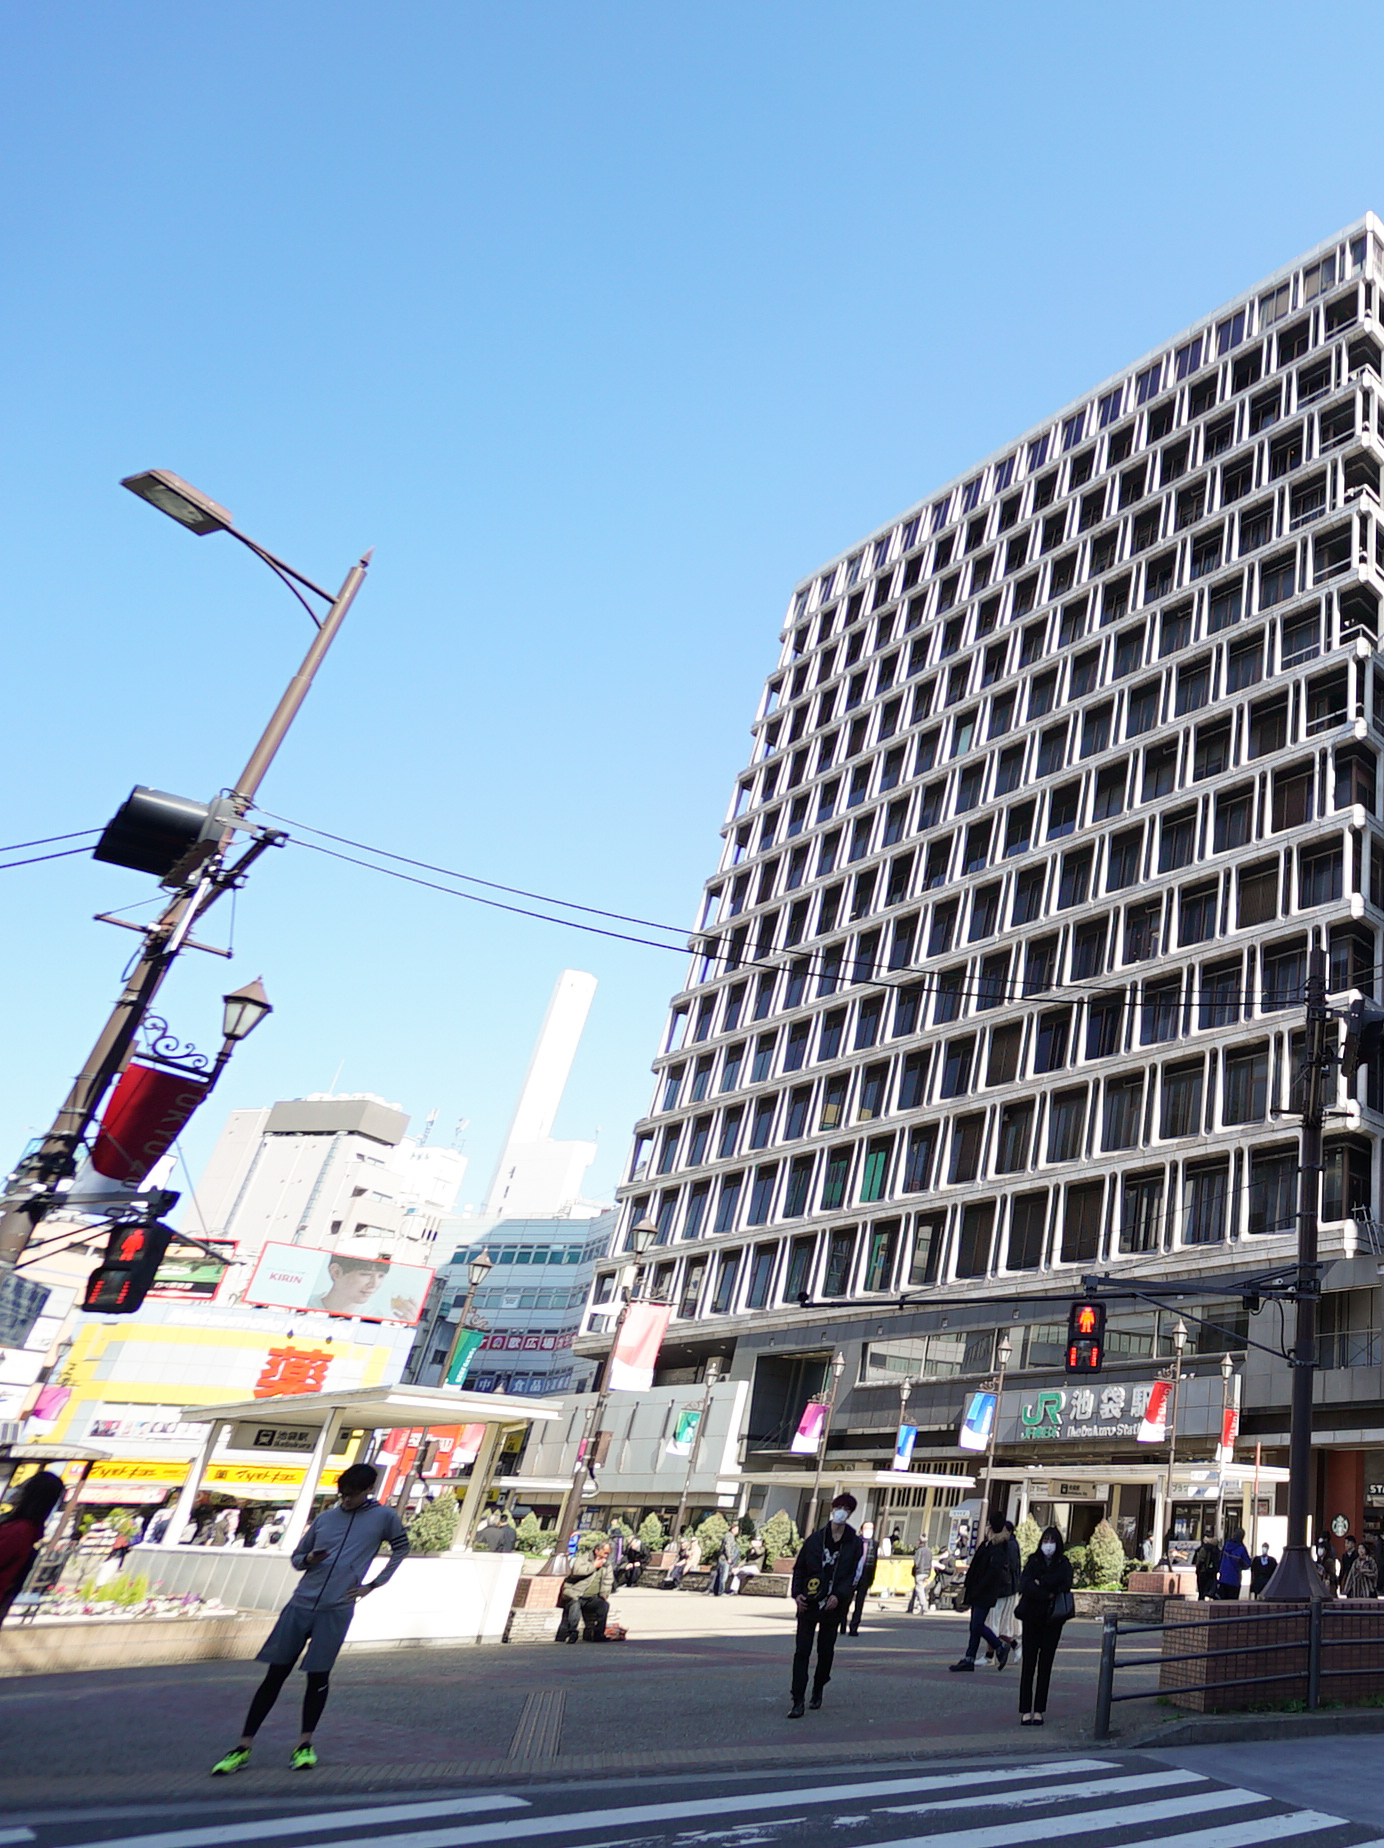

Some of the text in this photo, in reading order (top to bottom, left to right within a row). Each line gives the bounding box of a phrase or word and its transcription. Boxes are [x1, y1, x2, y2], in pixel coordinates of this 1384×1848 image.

[268, 1271, 304, 1285] KIRIN
[253, 1346, 335, 1400] 薬
[1022, 1391, 1066, 1425] JR
